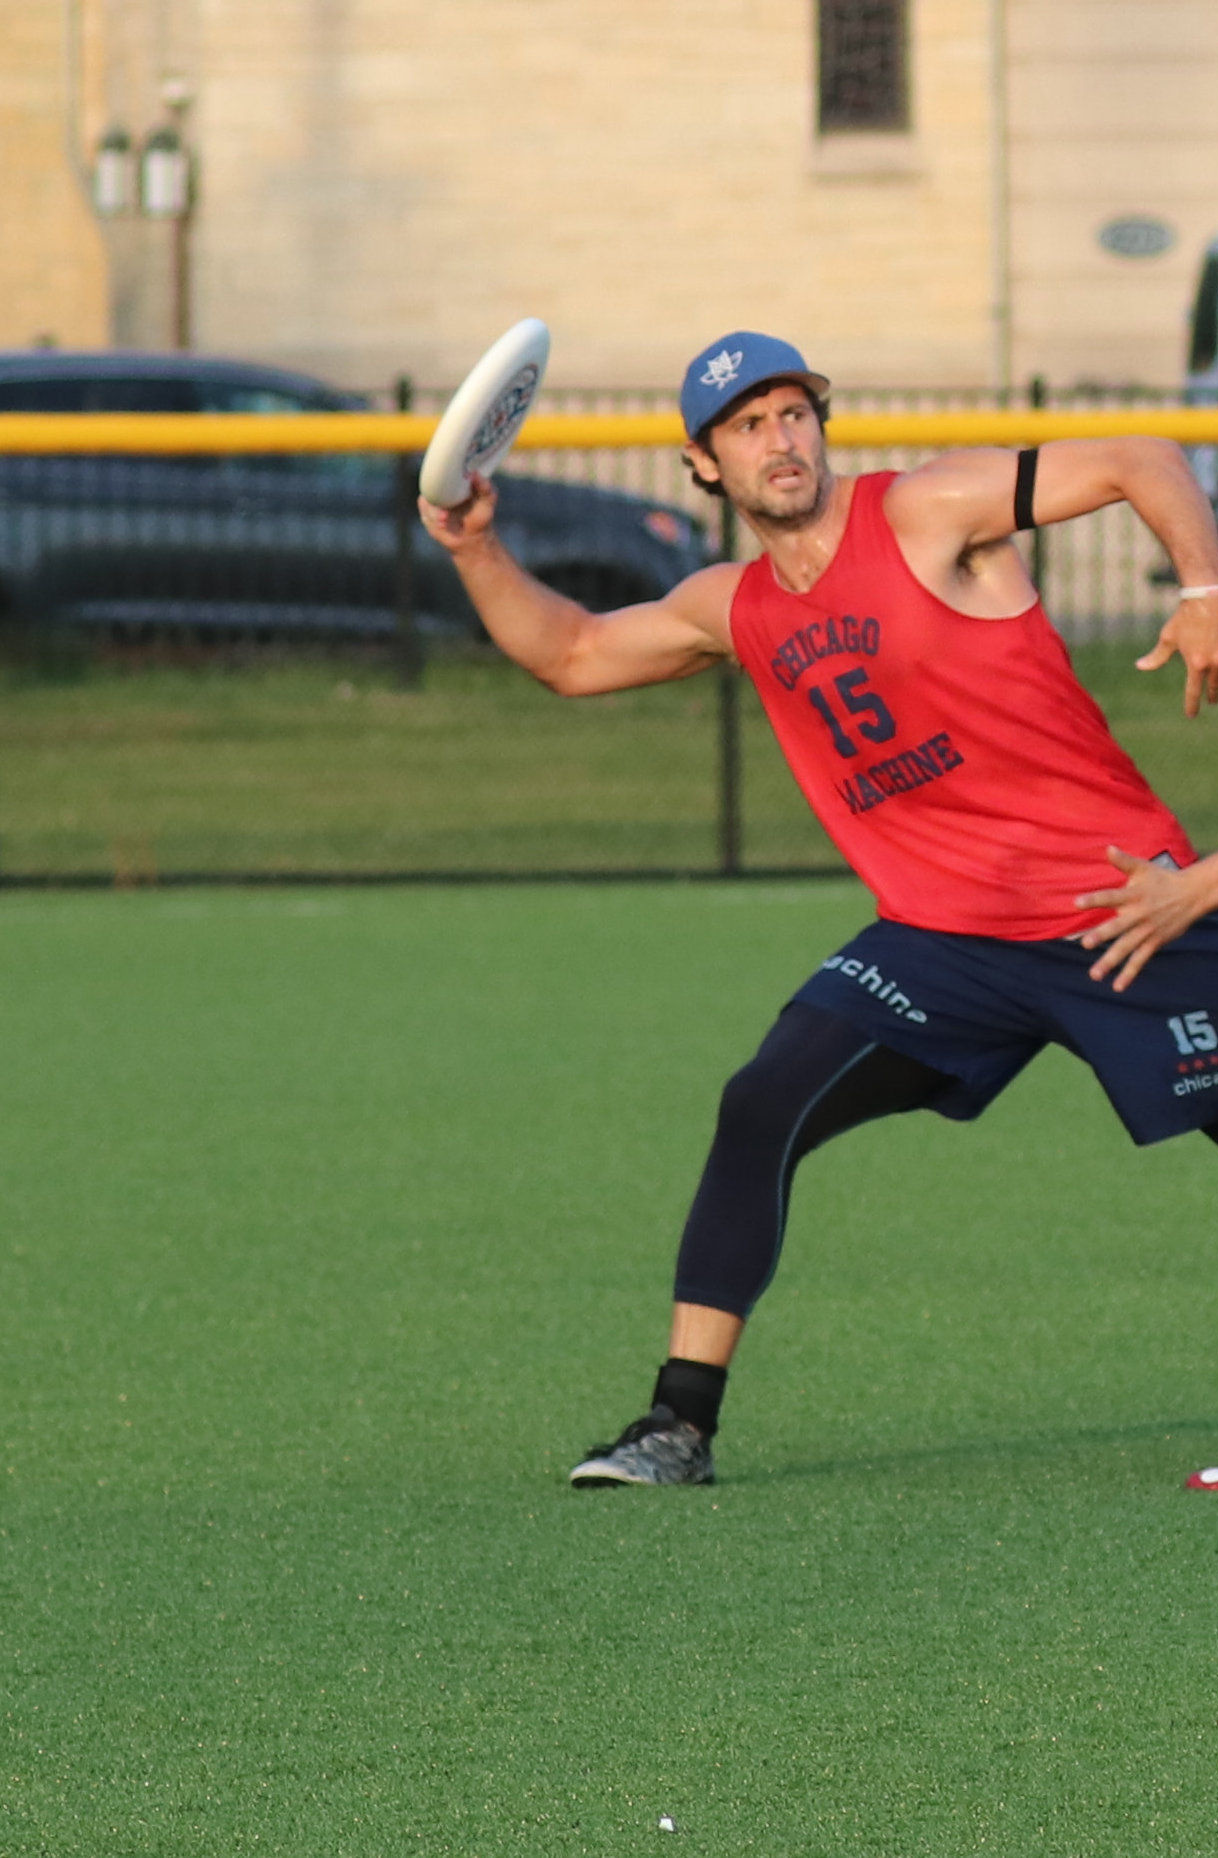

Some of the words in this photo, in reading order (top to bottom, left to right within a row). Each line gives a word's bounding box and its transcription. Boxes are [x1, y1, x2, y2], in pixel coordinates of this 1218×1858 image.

[771, 615, 880, 691] CHICAGO
[809, 667, 896, 759] 15
[1168, 1009, 1218, 1056] 15
